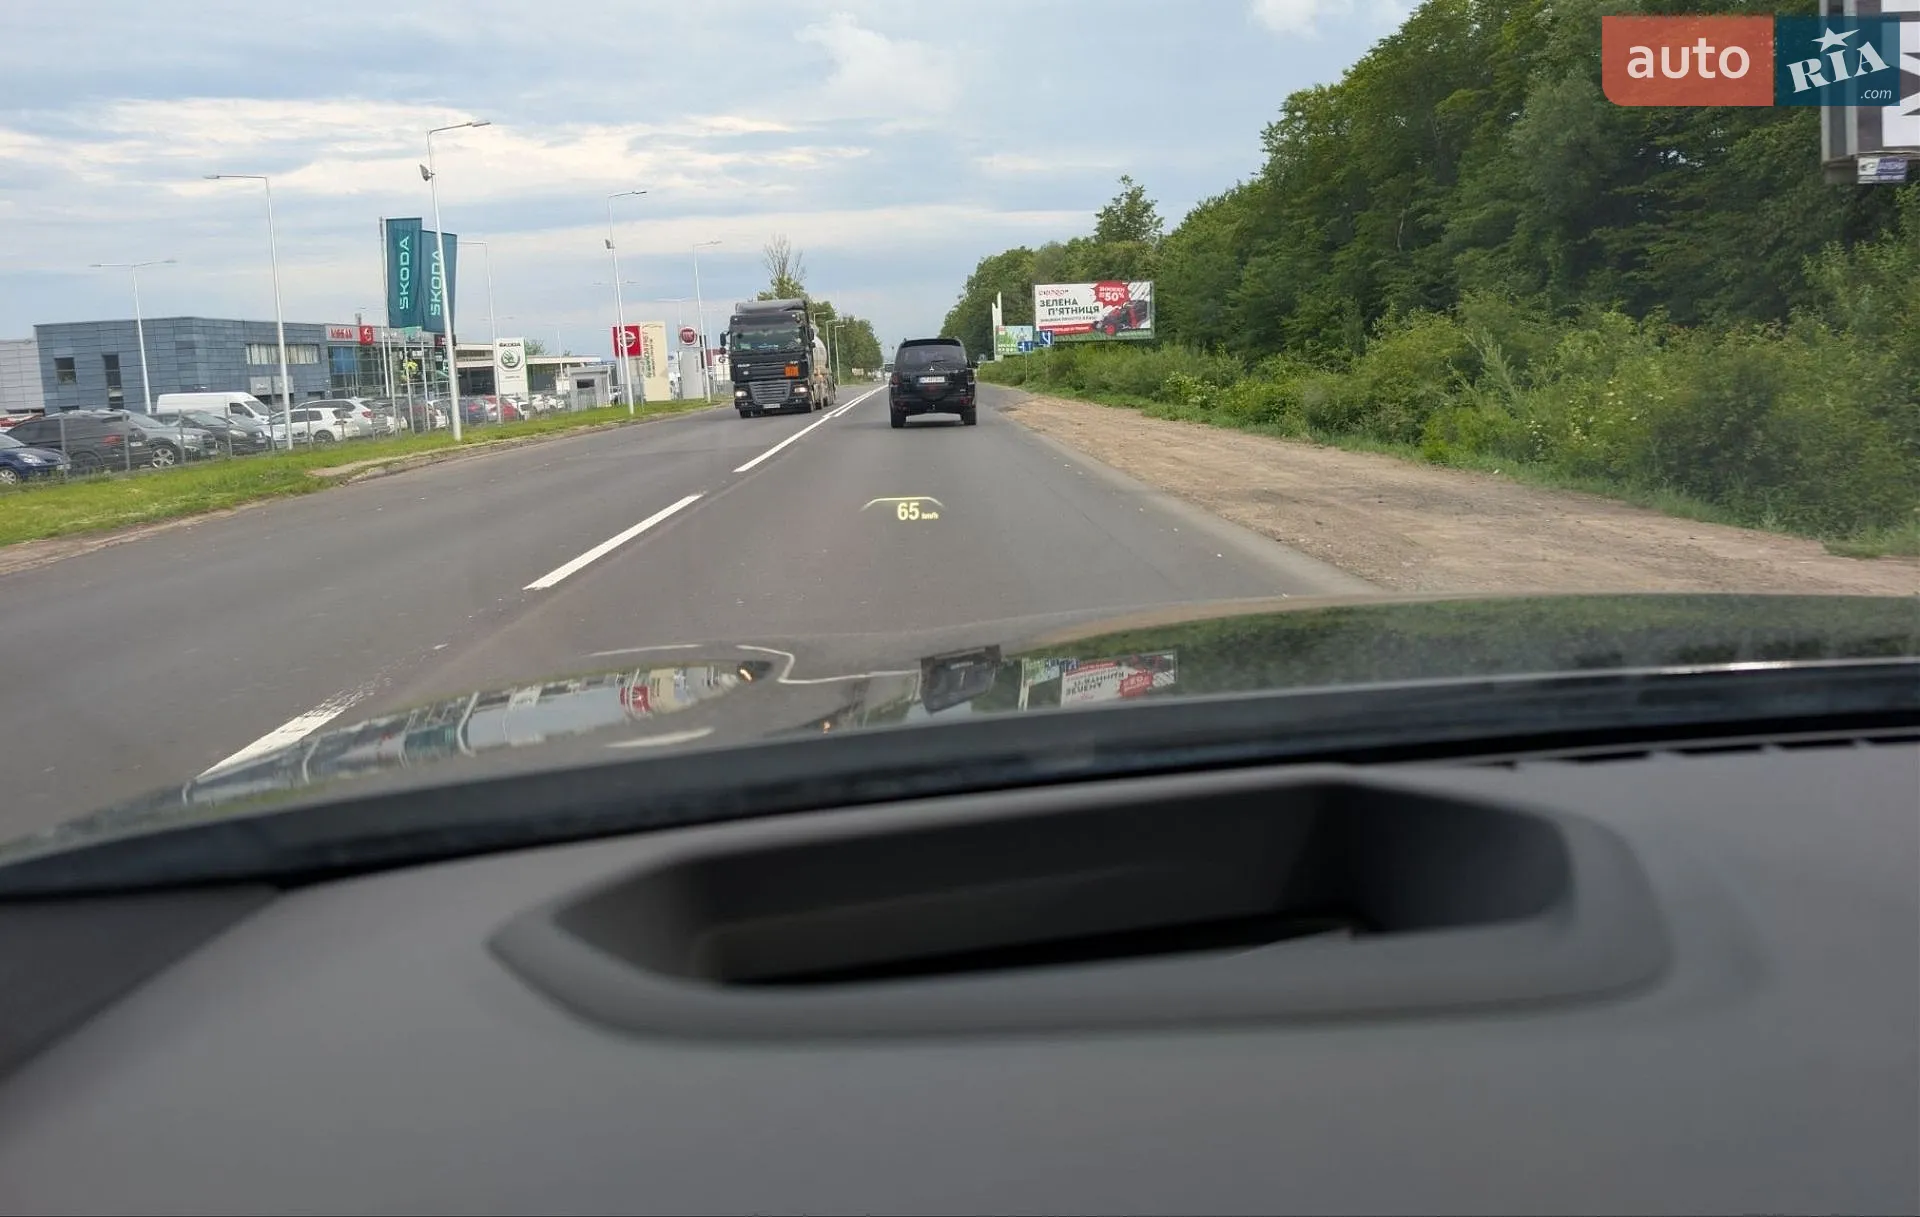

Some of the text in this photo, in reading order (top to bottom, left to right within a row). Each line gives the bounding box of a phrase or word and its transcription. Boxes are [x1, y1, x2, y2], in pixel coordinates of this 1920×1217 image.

[1104, 291, 1125, 302] 50%
[1040, 298, 1078, 307] ЗЕЛЕНА
[1048, 306, 1100, 316] П'ЯТНИЦЯ
[897, 502, 920, 520] 65
